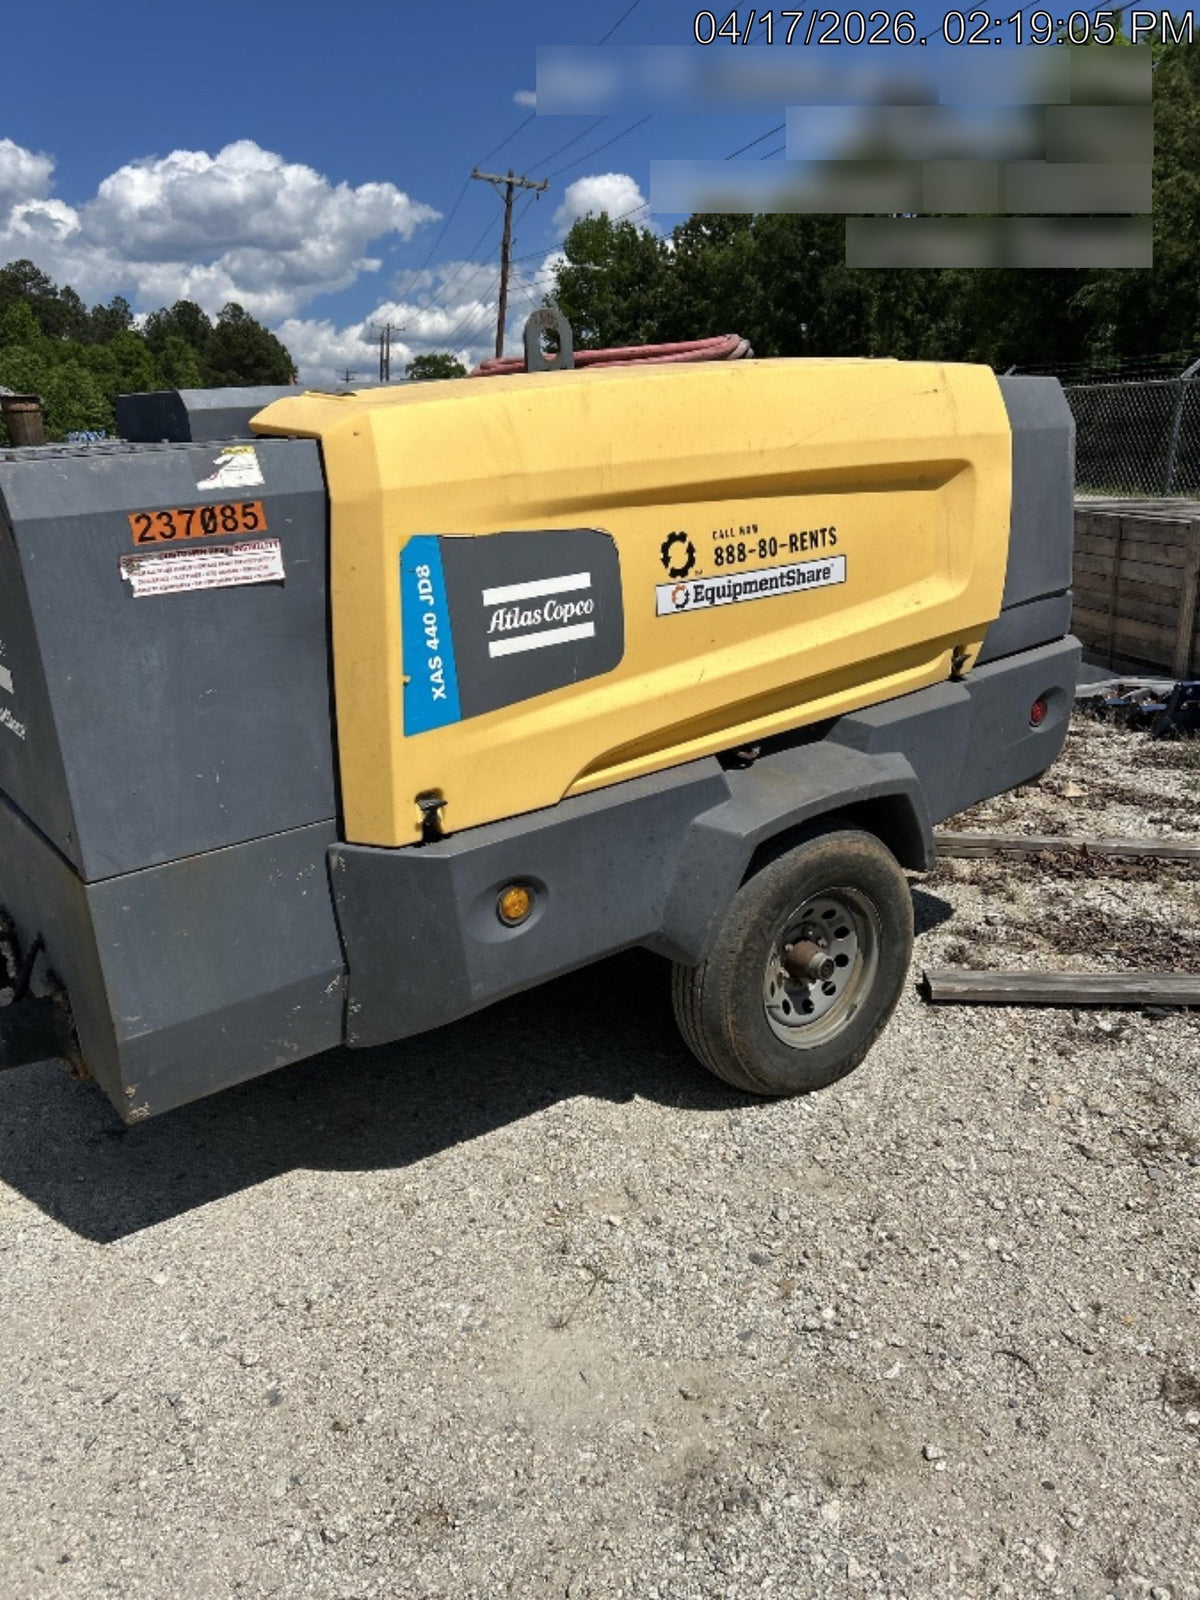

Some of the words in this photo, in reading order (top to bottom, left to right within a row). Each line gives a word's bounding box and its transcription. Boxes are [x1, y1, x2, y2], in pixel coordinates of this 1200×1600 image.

[134, 502, 259, 543] 237085
[712, 528, 735, 540] CALL
[739, 524, 759, 536] NOW
[714, 526, 837, 567] 888-80-RENTS
[415, 564, 435, 606] JD8
[693, 567, 832, 605] EquipmentShare
[422, 612, 440, 650] 440
[487, 606, 542, 634] Atlas
[543, 598, 594, 623] Copco
[428, 656, 447, 701] XAS
